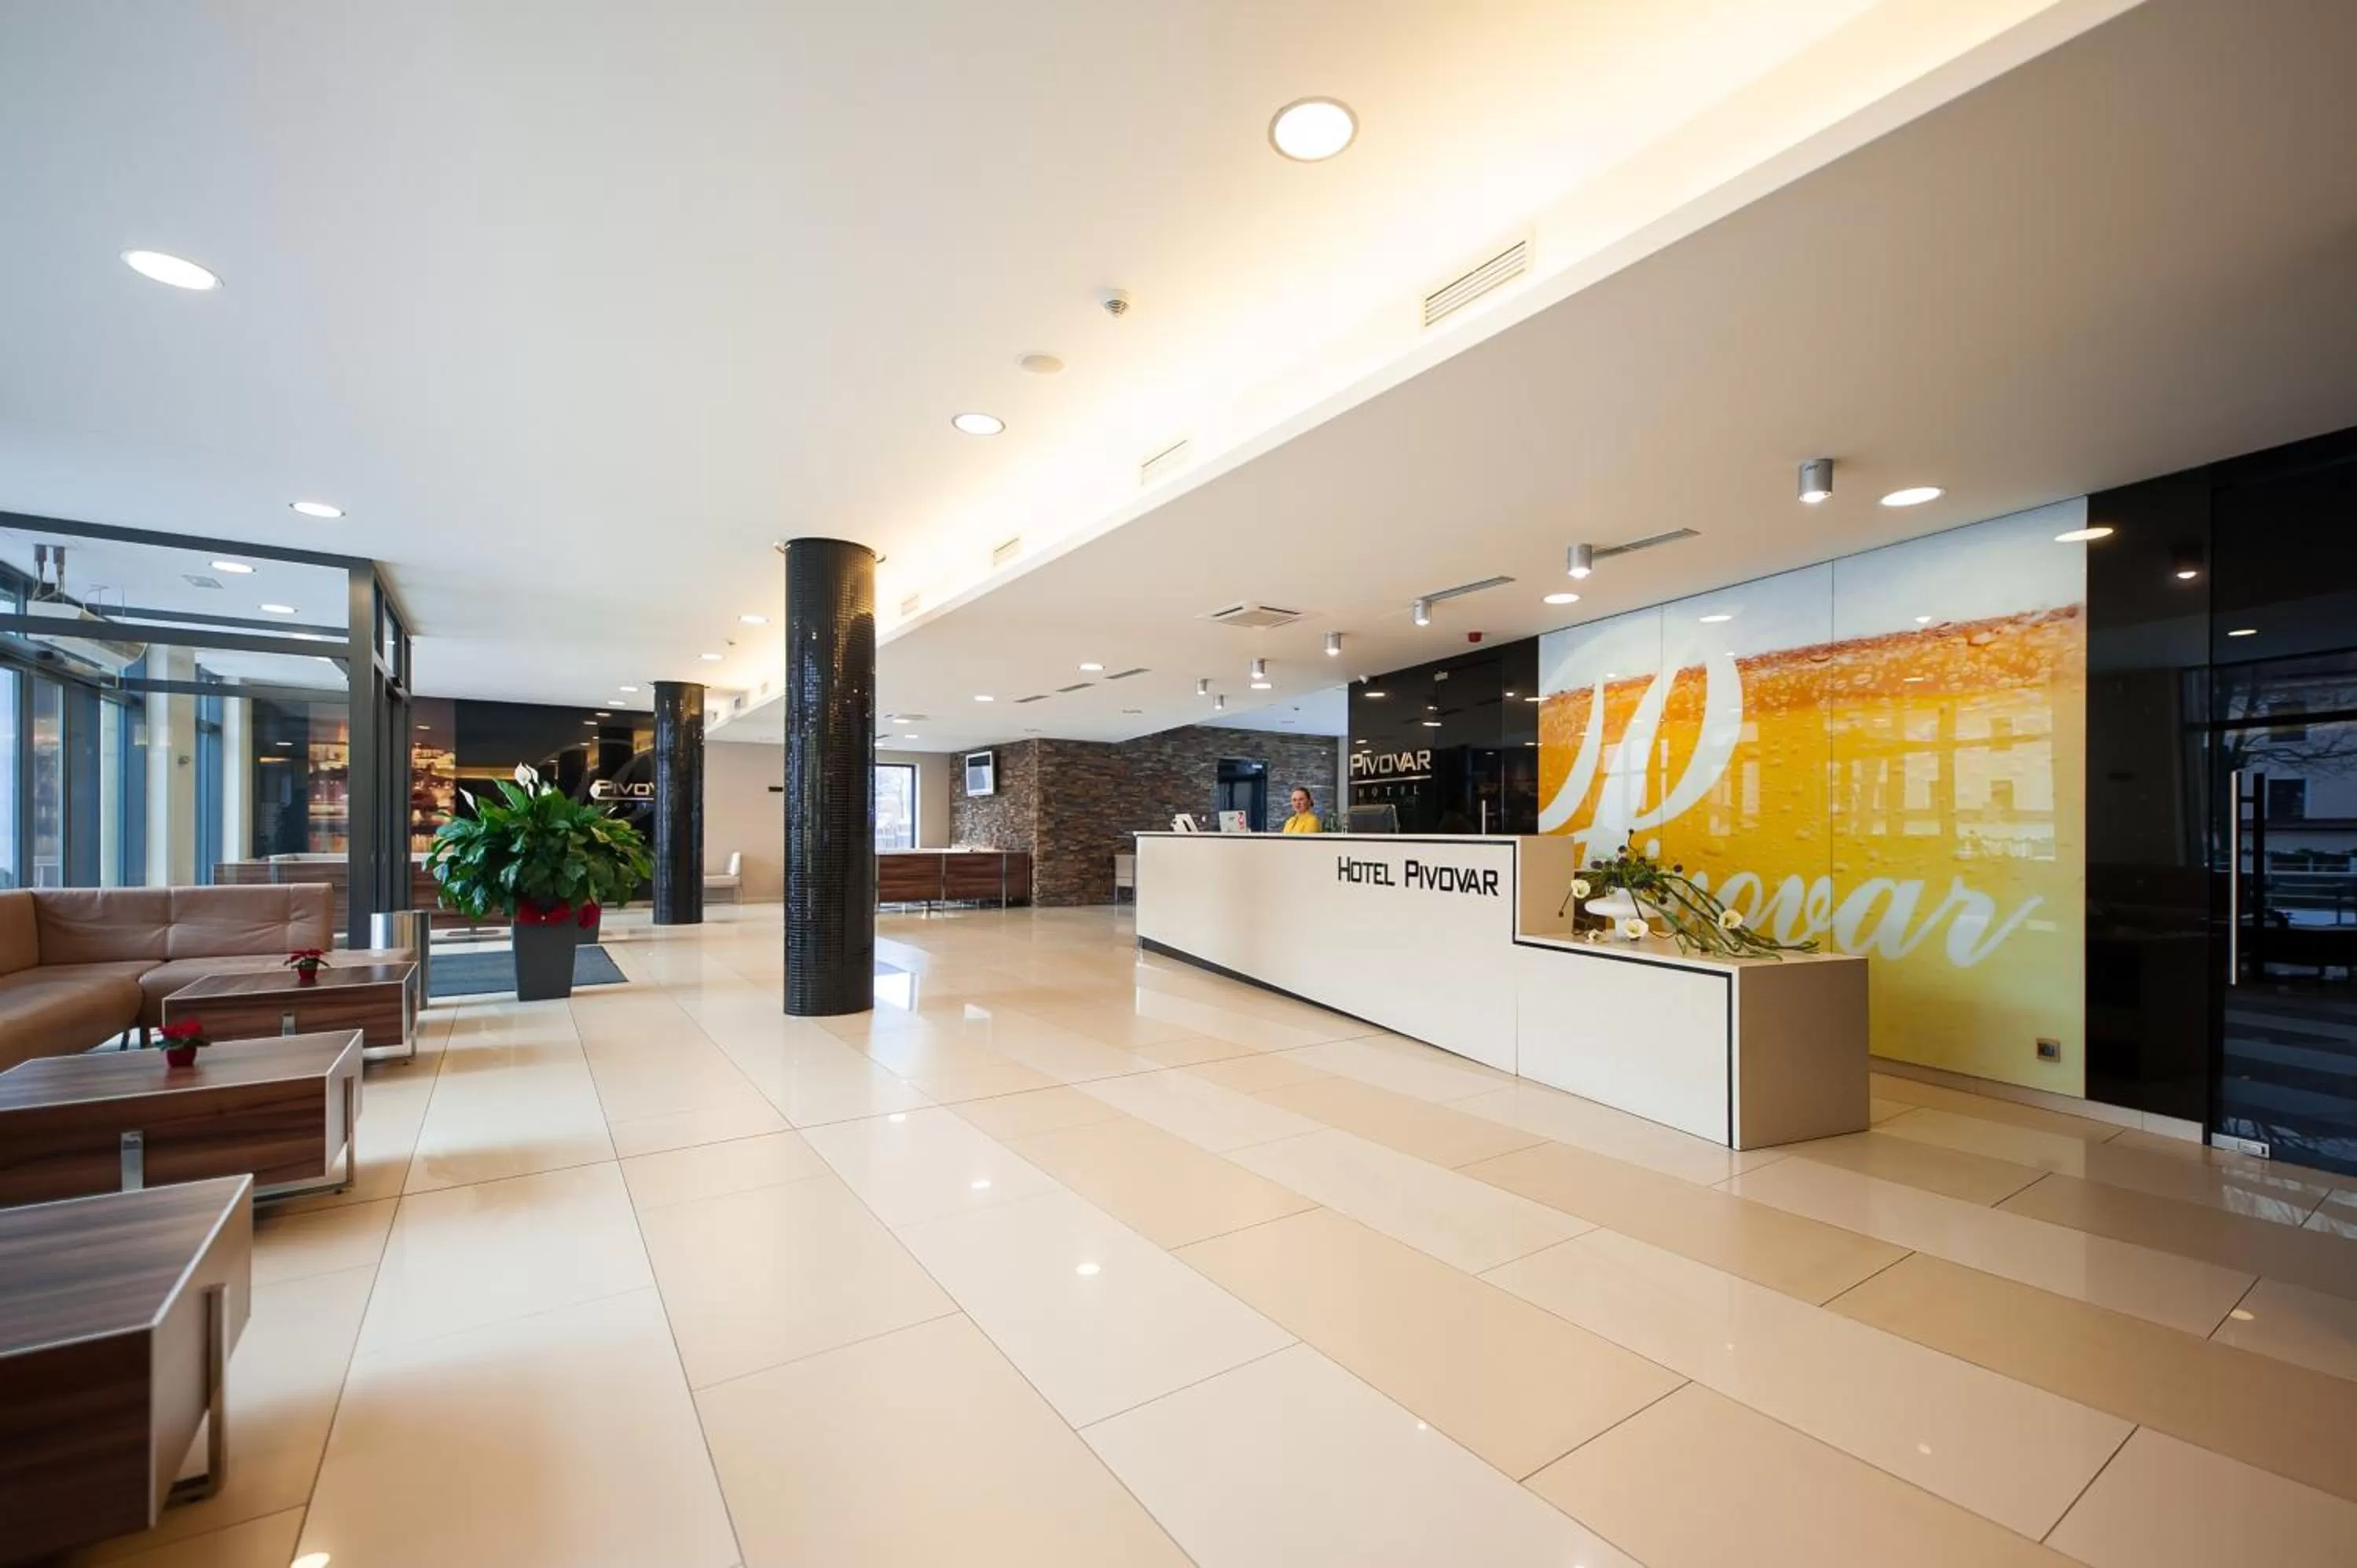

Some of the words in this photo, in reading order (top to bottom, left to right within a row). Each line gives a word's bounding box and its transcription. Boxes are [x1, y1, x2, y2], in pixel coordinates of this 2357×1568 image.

[1349, 749, 1431, 777] PIVOVAR
[1337, 855, 1395, 887] HOTEL
[1404, 859, 1499, 896] PIVOVAR
